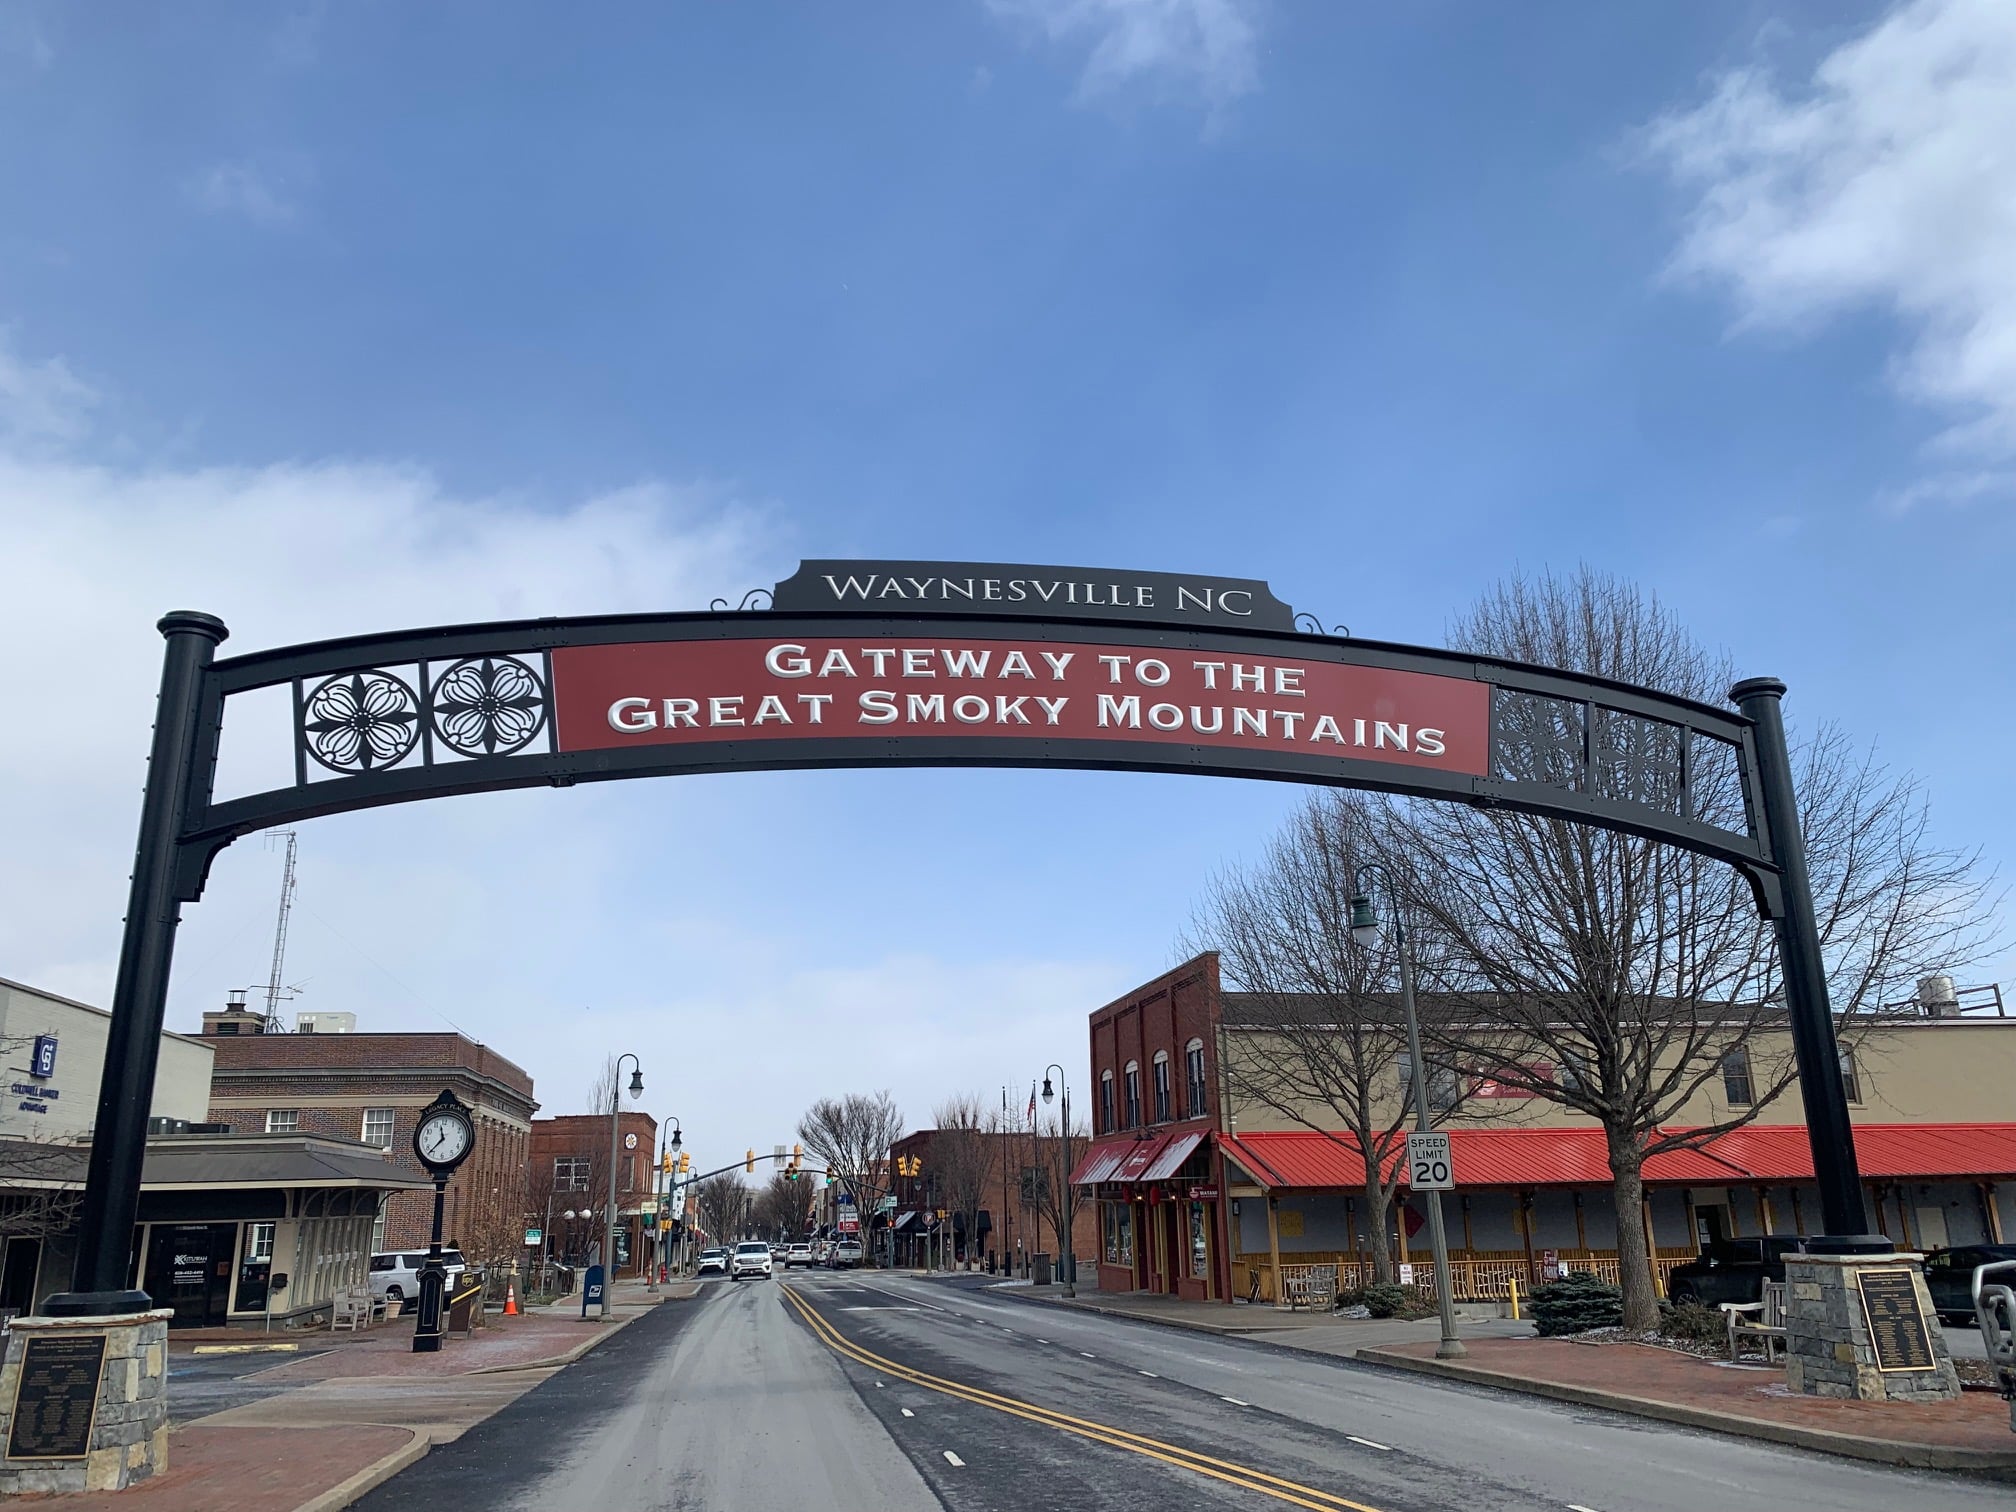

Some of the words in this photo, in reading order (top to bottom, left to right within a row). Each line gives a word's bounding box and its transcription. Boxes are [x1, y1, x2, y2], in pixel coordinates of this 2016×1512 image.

[823, 574, 1154, 607] WAYNESVILLE
[1175, 586, 1253, 617] NC
[765, 643, 1075, 681] GATEWAY
[1098, 654, 1171, 688] TO
[1193, 660, 1306, 697] THE
[607, 692, 833, 733] GREAT
[858, 690, 1070, 726] SMOKY
[1096, 693, 1446, 757] MOUNTAINS
[425, 1104, 447, 1115] LEGACY
[1411, 1138, 1447, 1148] SPEED
[1416, 1150, 1443, 1160] LIMIT
[1415, 1161, 1448, 1183] 20
